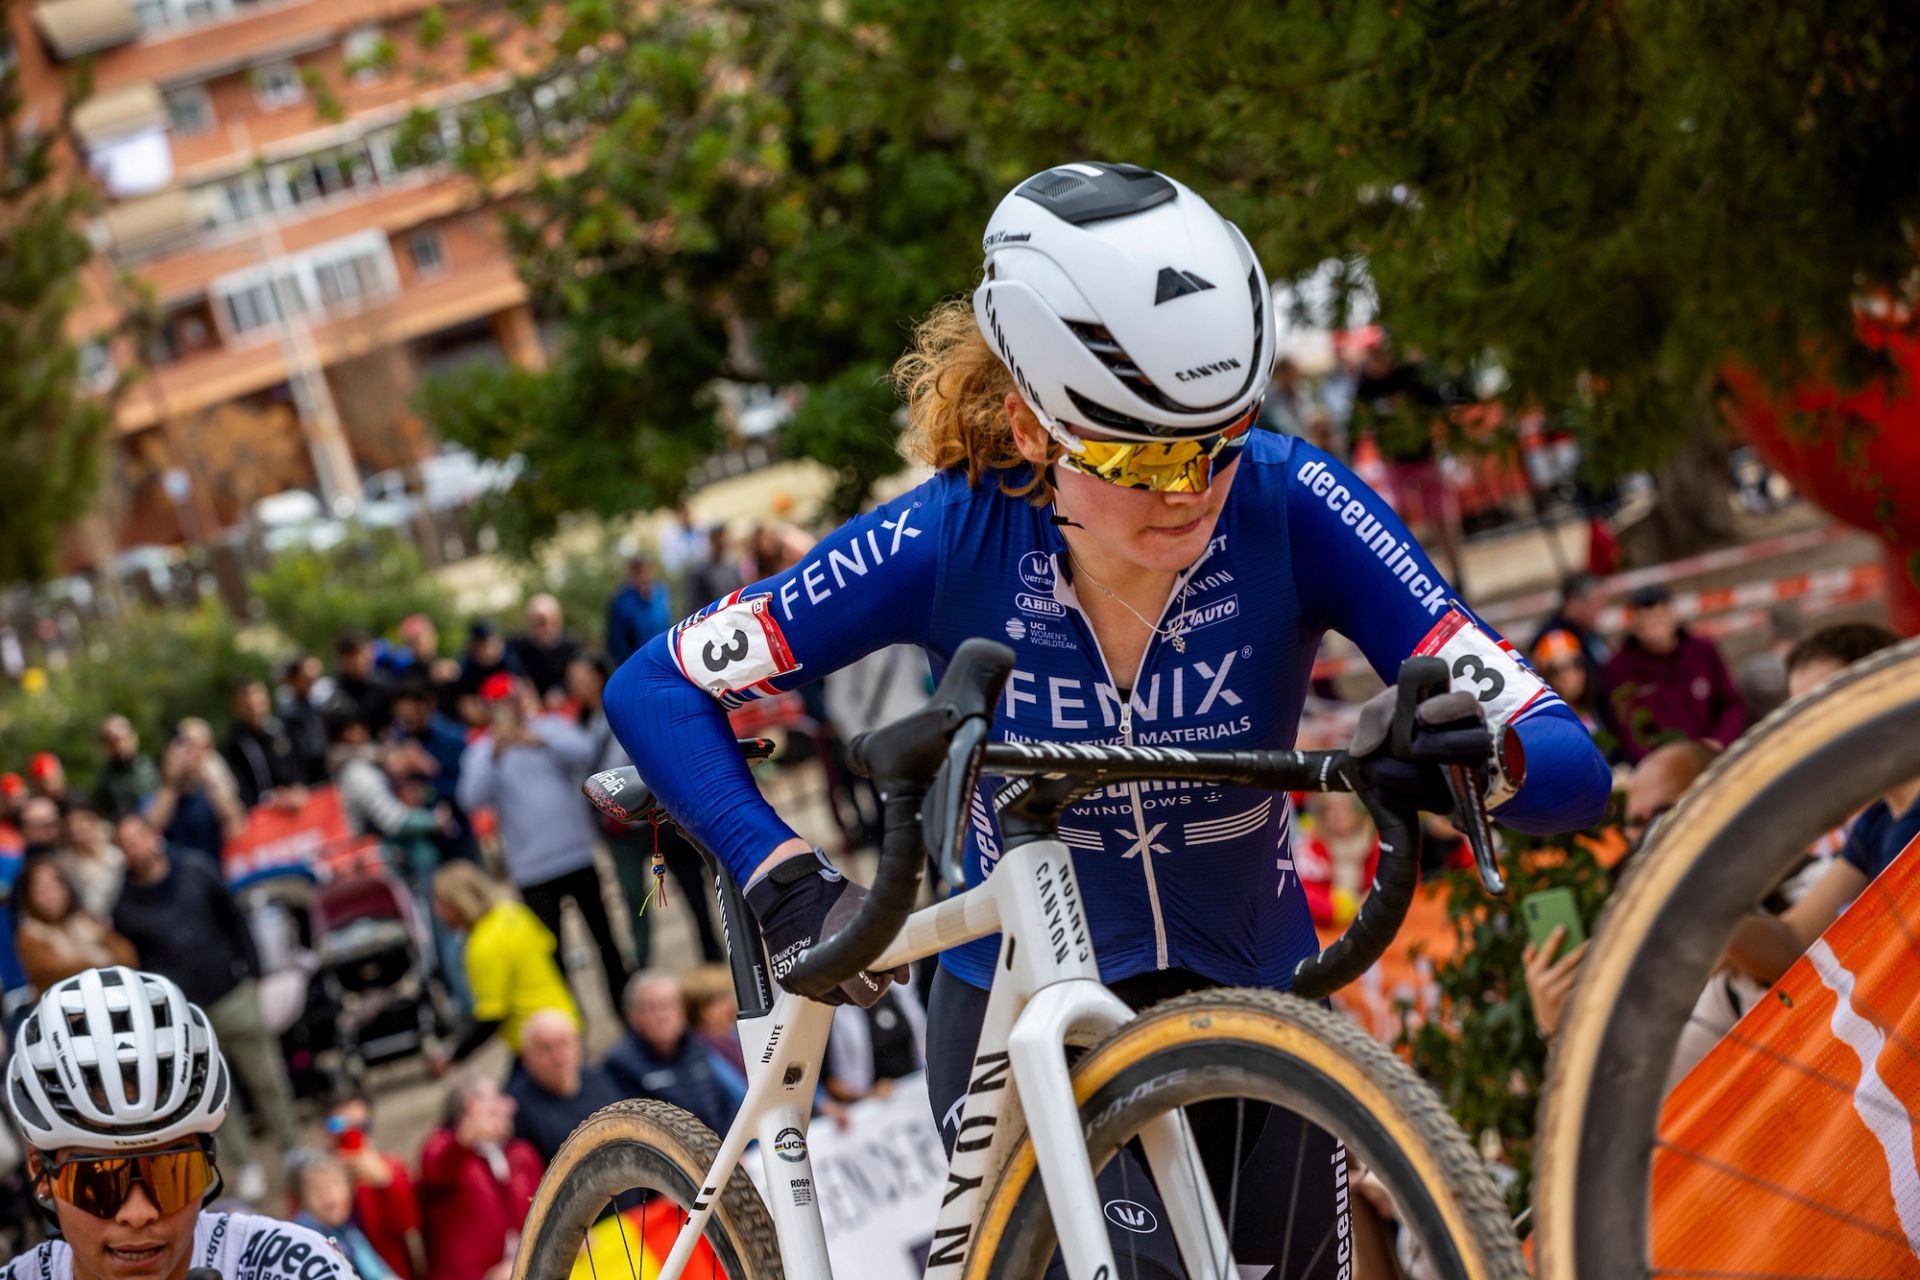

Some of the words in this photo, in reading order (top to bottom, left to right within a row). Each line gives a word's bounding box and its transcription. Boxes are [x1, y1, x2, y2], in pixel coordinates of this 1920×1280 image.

[1175, 358, 1241, 382] CANYON
[1297, 460, 1448, 617] deceuninck
[780, 508, 922, 622] FENIX
[1022, 597, 1060, 613] ABUS
[1030, 621, 1046, 631] UCI
[1030, 630, 1068, 642] WOMEN'S
[1030, 637, 1078, 651] WORLDTEAM
[702, 629, 749, 673] 3
[1004, 650, 1244, 730] FENIX
[1452, 654, 1505, 702] 3
[1139, 715, 1252, 745] MATERIALS
[994, 778, 1030, 813] ANYON
[1072, 795, 1192, 816] WINDOWS
[1036, 862, 1069, 965] CANYON
[1058, 864, 1088, 963] CANYON
[761, 1023, 784, 1064] INFLITE
[928, 1050, 1010, 1269] NYON
